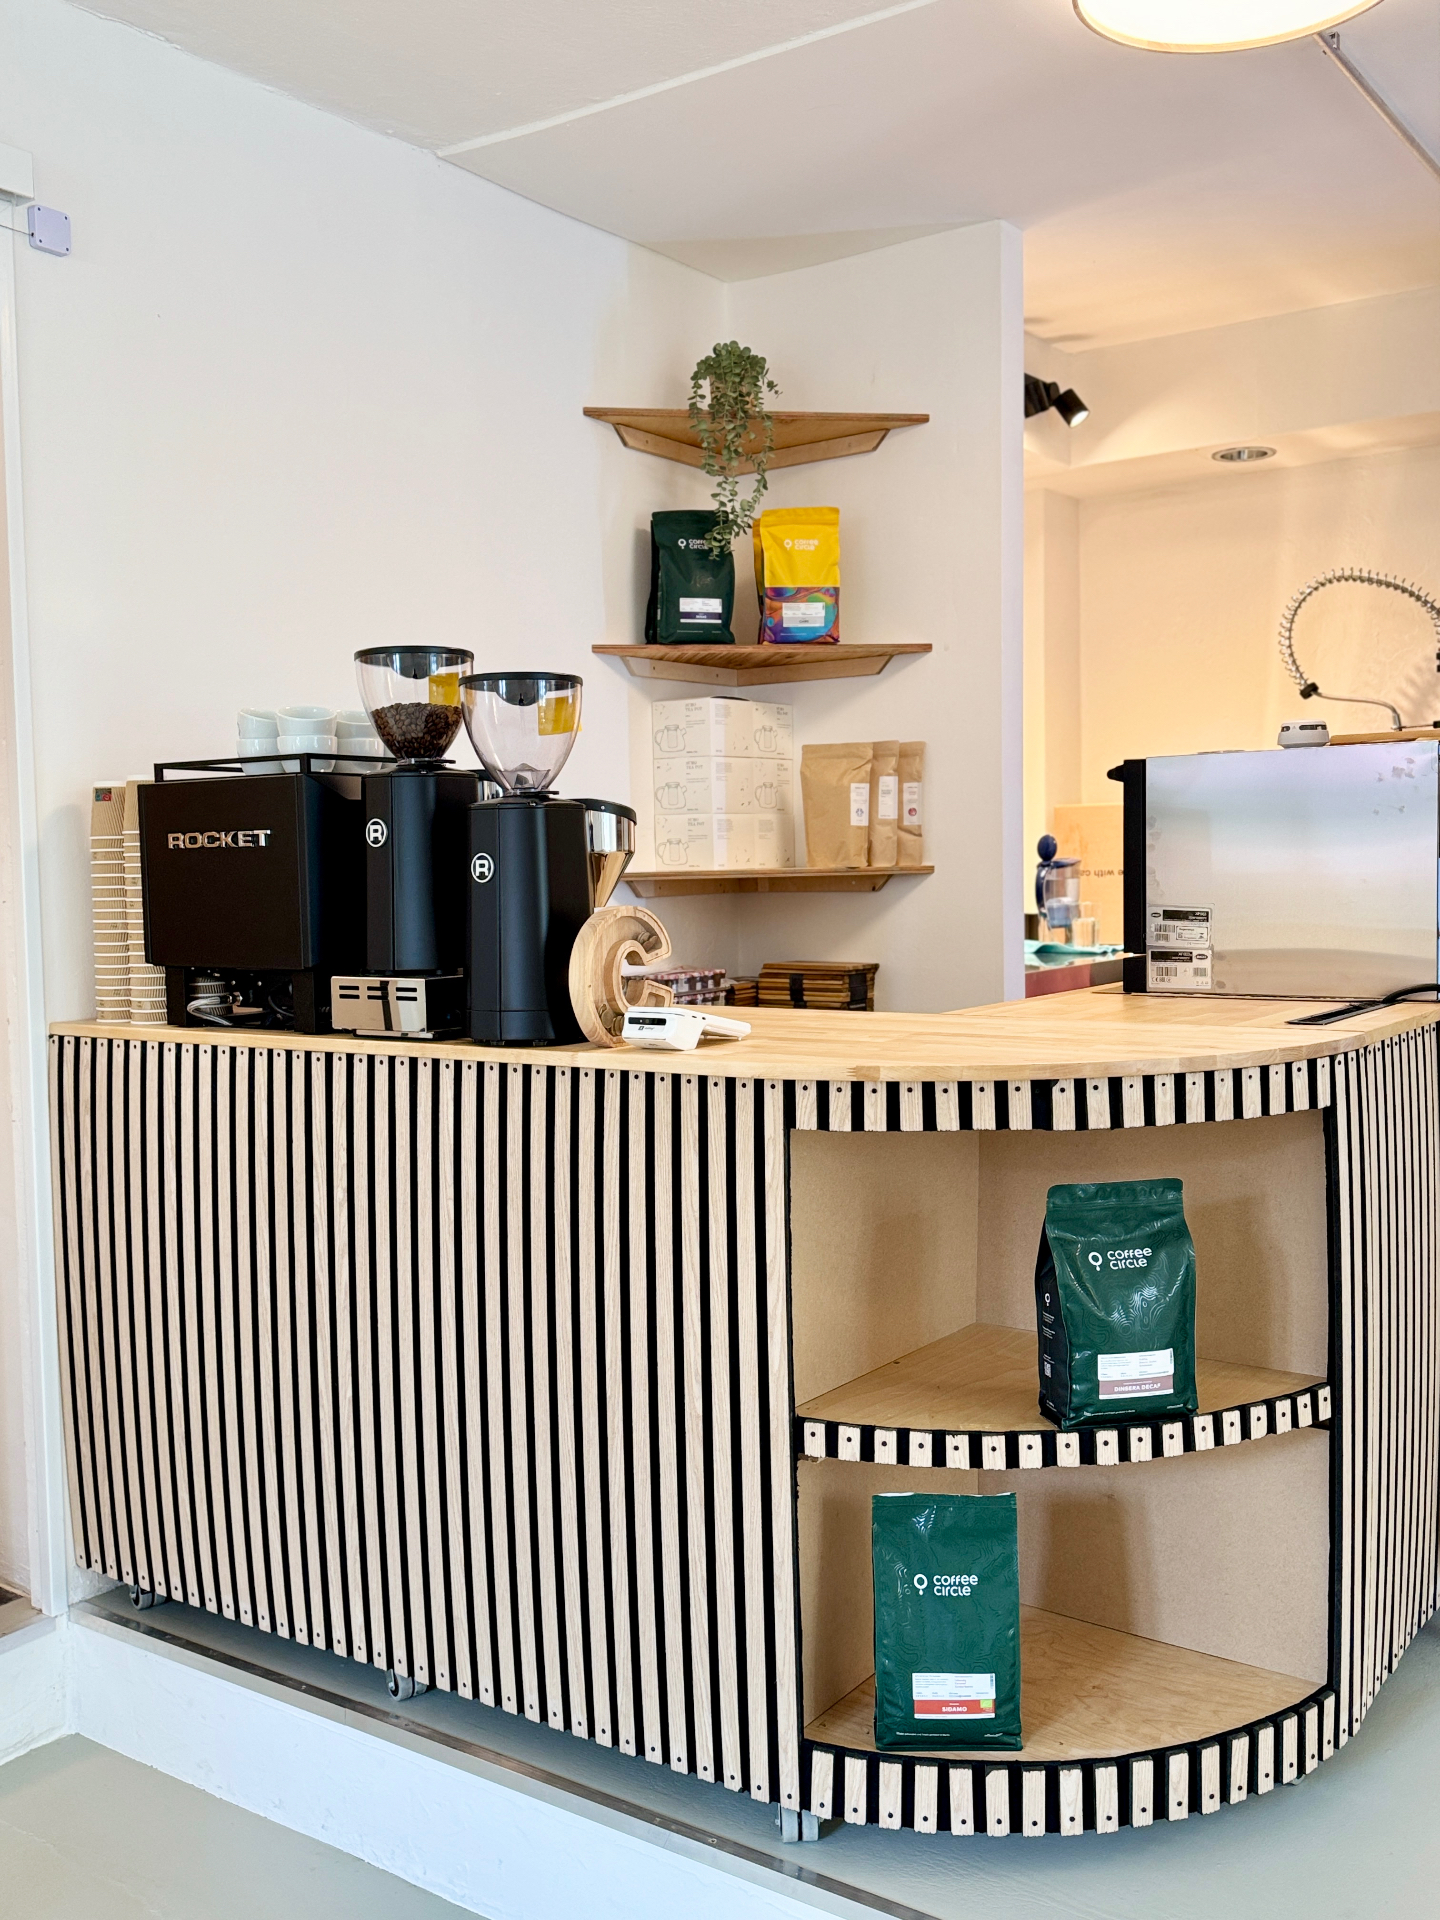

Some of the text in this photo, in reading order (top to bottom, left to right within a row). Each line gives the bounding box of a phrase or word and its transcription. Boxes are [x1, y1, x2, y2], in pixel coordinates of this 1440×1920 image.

[369, 824, 383, 841] R
[167, 829, 271, 849] ROCKET
[475, 860, 489, 877] R
[1094, 870, 1115, 878] with
[1107, 1247, 1153, 1260] coffee
[1110, 1258, 1148, 1270] circle
[933, 1574, 979, 1586] coffee
[933, 1585, 972, 1597] circle
